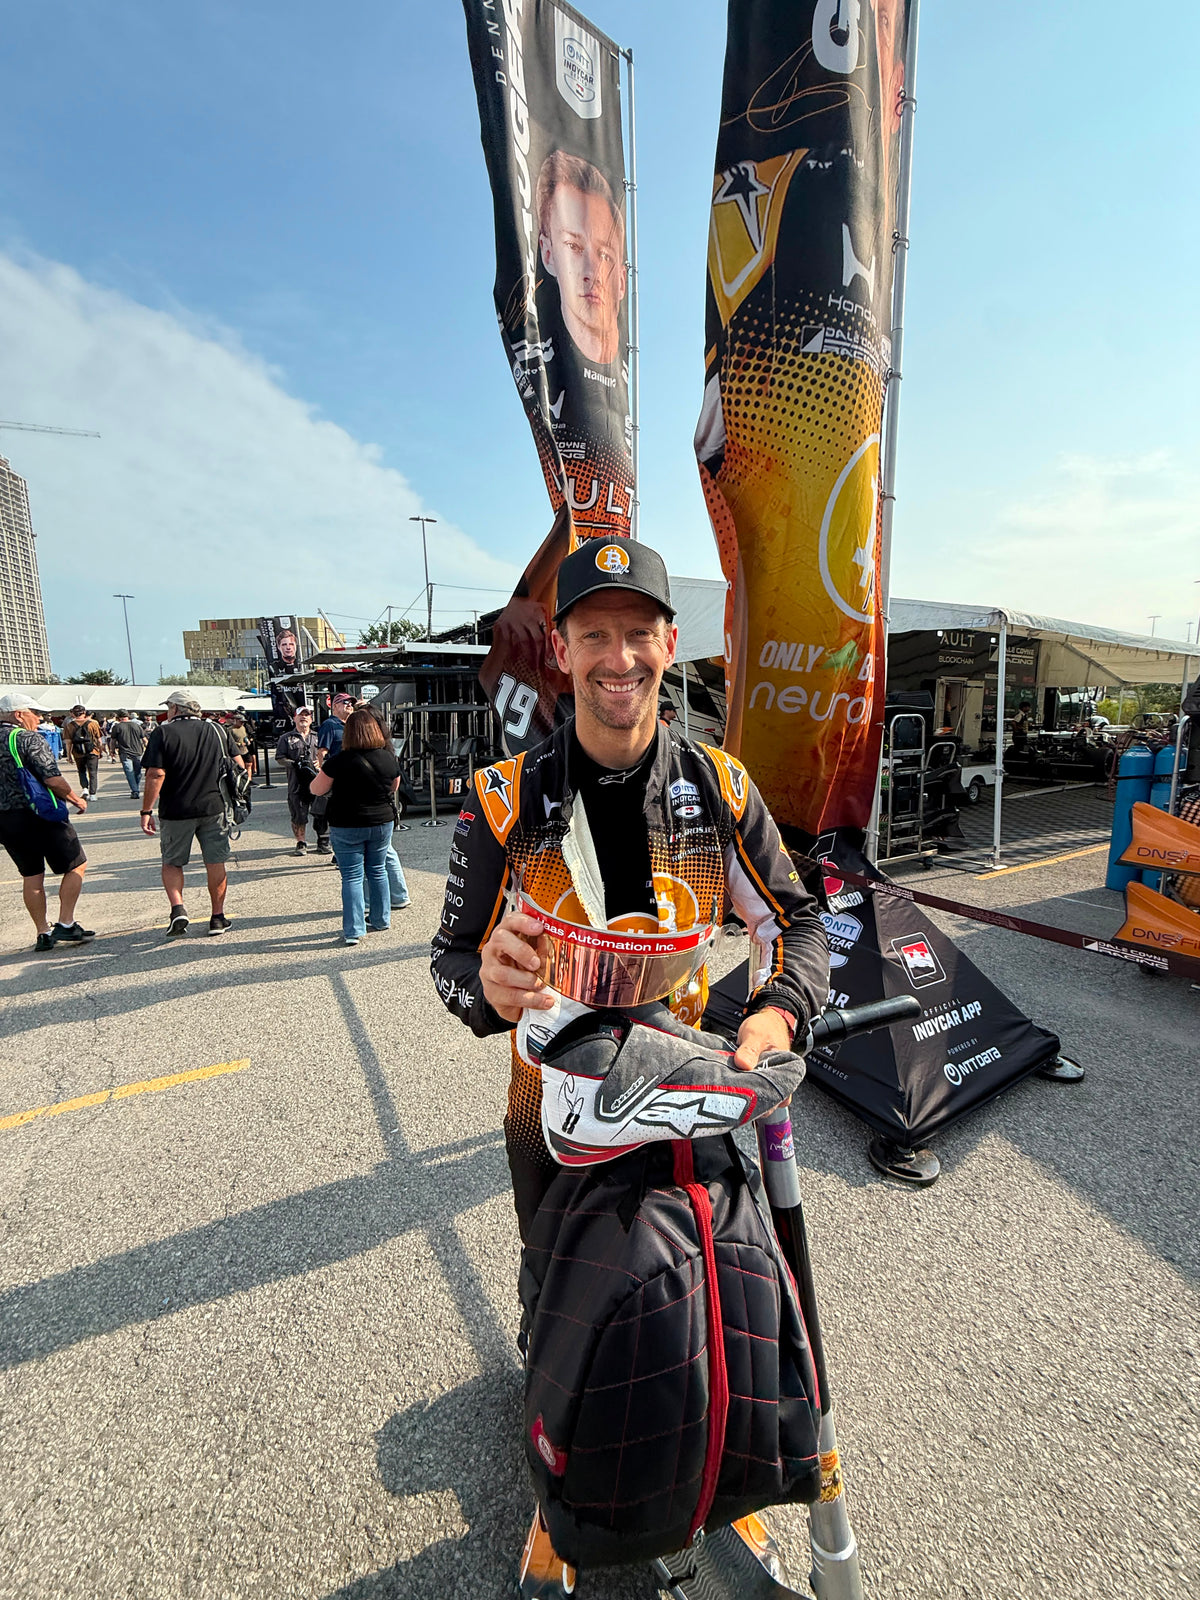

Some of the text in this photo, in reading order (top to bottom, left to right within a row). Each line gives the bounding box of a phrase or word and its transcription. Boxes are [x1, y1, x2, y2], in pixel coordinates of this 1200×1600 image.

[563, 59, 594, 85] INDYCAR
[940, 632, 976, 648] AULT
[759, 640, 825, 673] ONLY
[938, 655, 974, 665] BLOCKCHAIN
[494, 672, 539, 739] 19
[275, 719, 287, 728] 27
[449, 778, 463, 795] 18
[833, 920, 858, 935] NTT
[567, 931, 651, 951] Automation
[655, 943, 677, 952] Inc.
[1099, 941, 1169, 963] DALE COYNE
[1099, 949, 1169, 970] RACING
[923, 998, 961, 1017] OFFICIAL
[912, 1000, 982, 1042] INDYCAR APP
[947, 1038, 978, 1056] POWERED BY
[807, 1054, 849, 1081] ANY DEVICE
